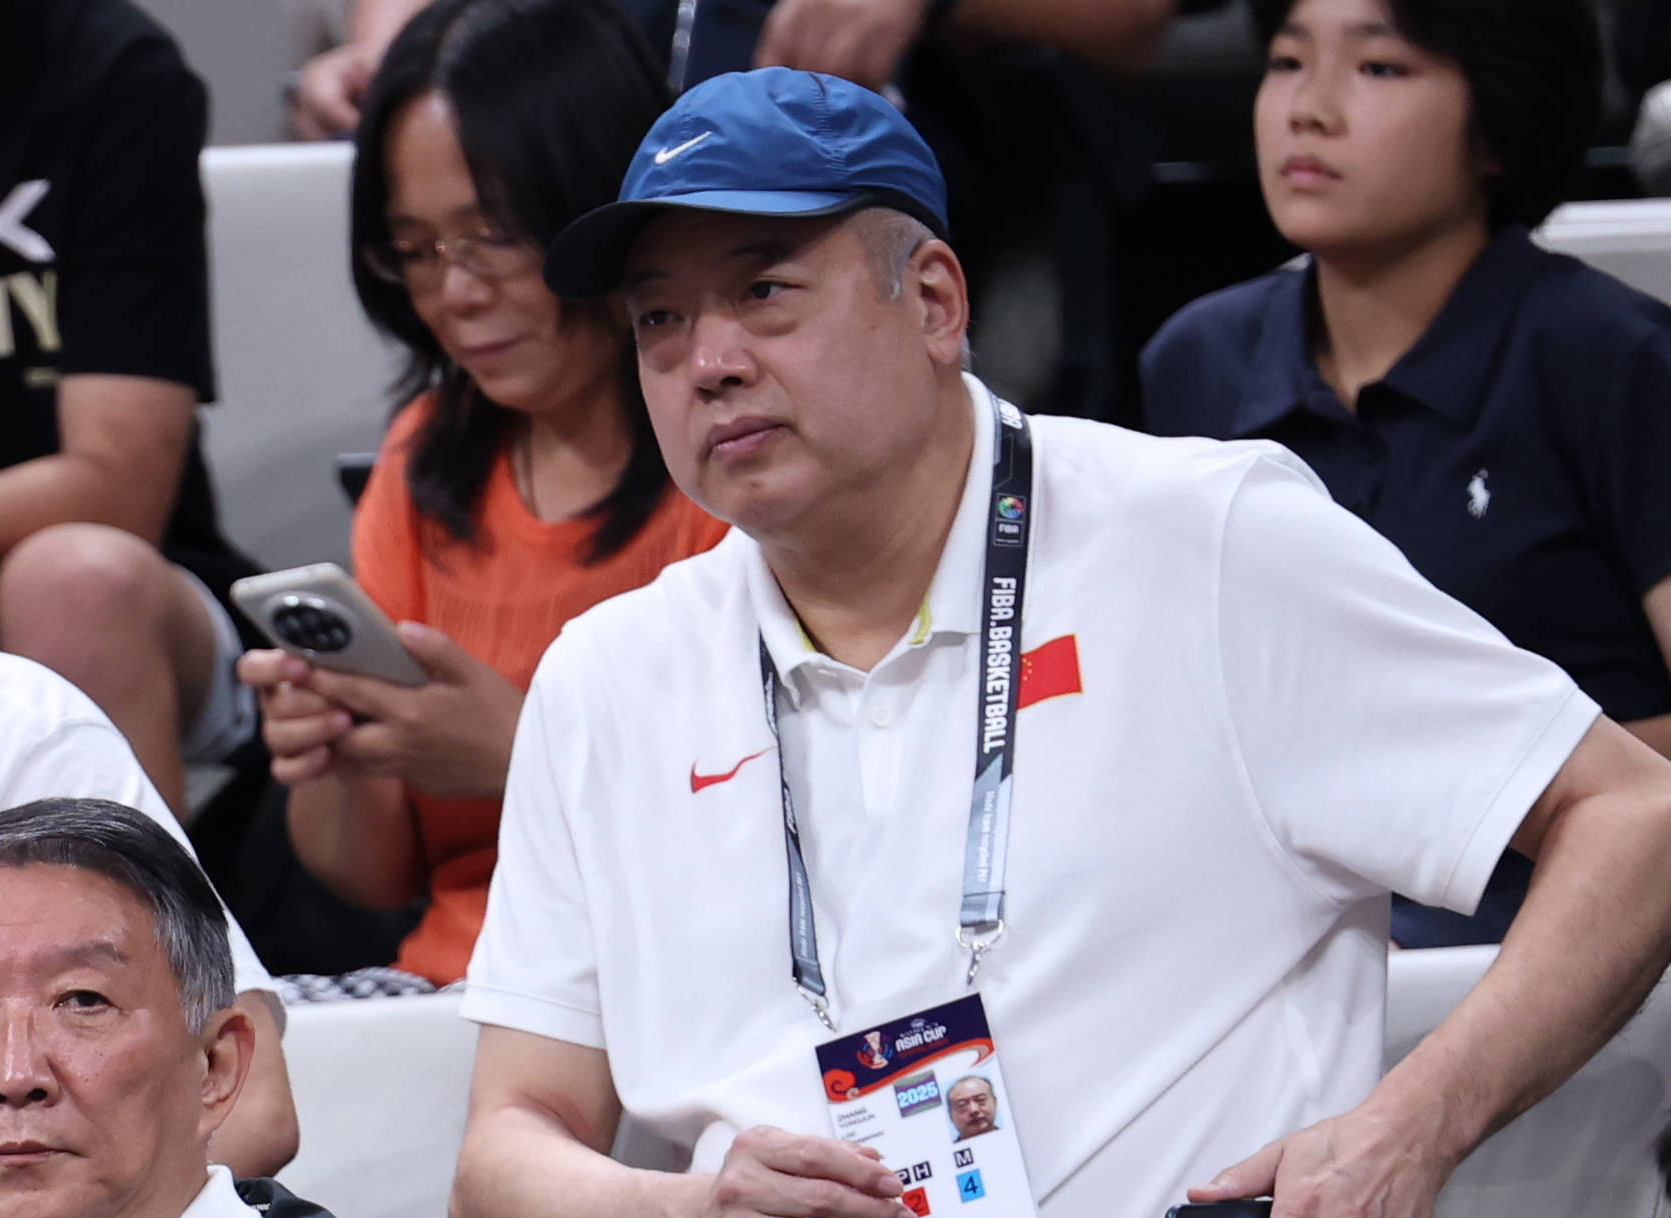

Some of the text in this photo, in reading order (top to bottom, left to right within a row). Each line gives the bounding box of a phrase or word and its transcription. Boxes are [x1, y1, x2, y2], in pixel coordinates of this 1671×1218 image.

[983, 577, 1017, 754] FIBA.BASKETBALL
[896, 1081, 939, 1108] 2025
[915, 1164, 930, 1180] H
[956, 1149, 972, 1167] M
[964, 1177, 979, 1194] 4
